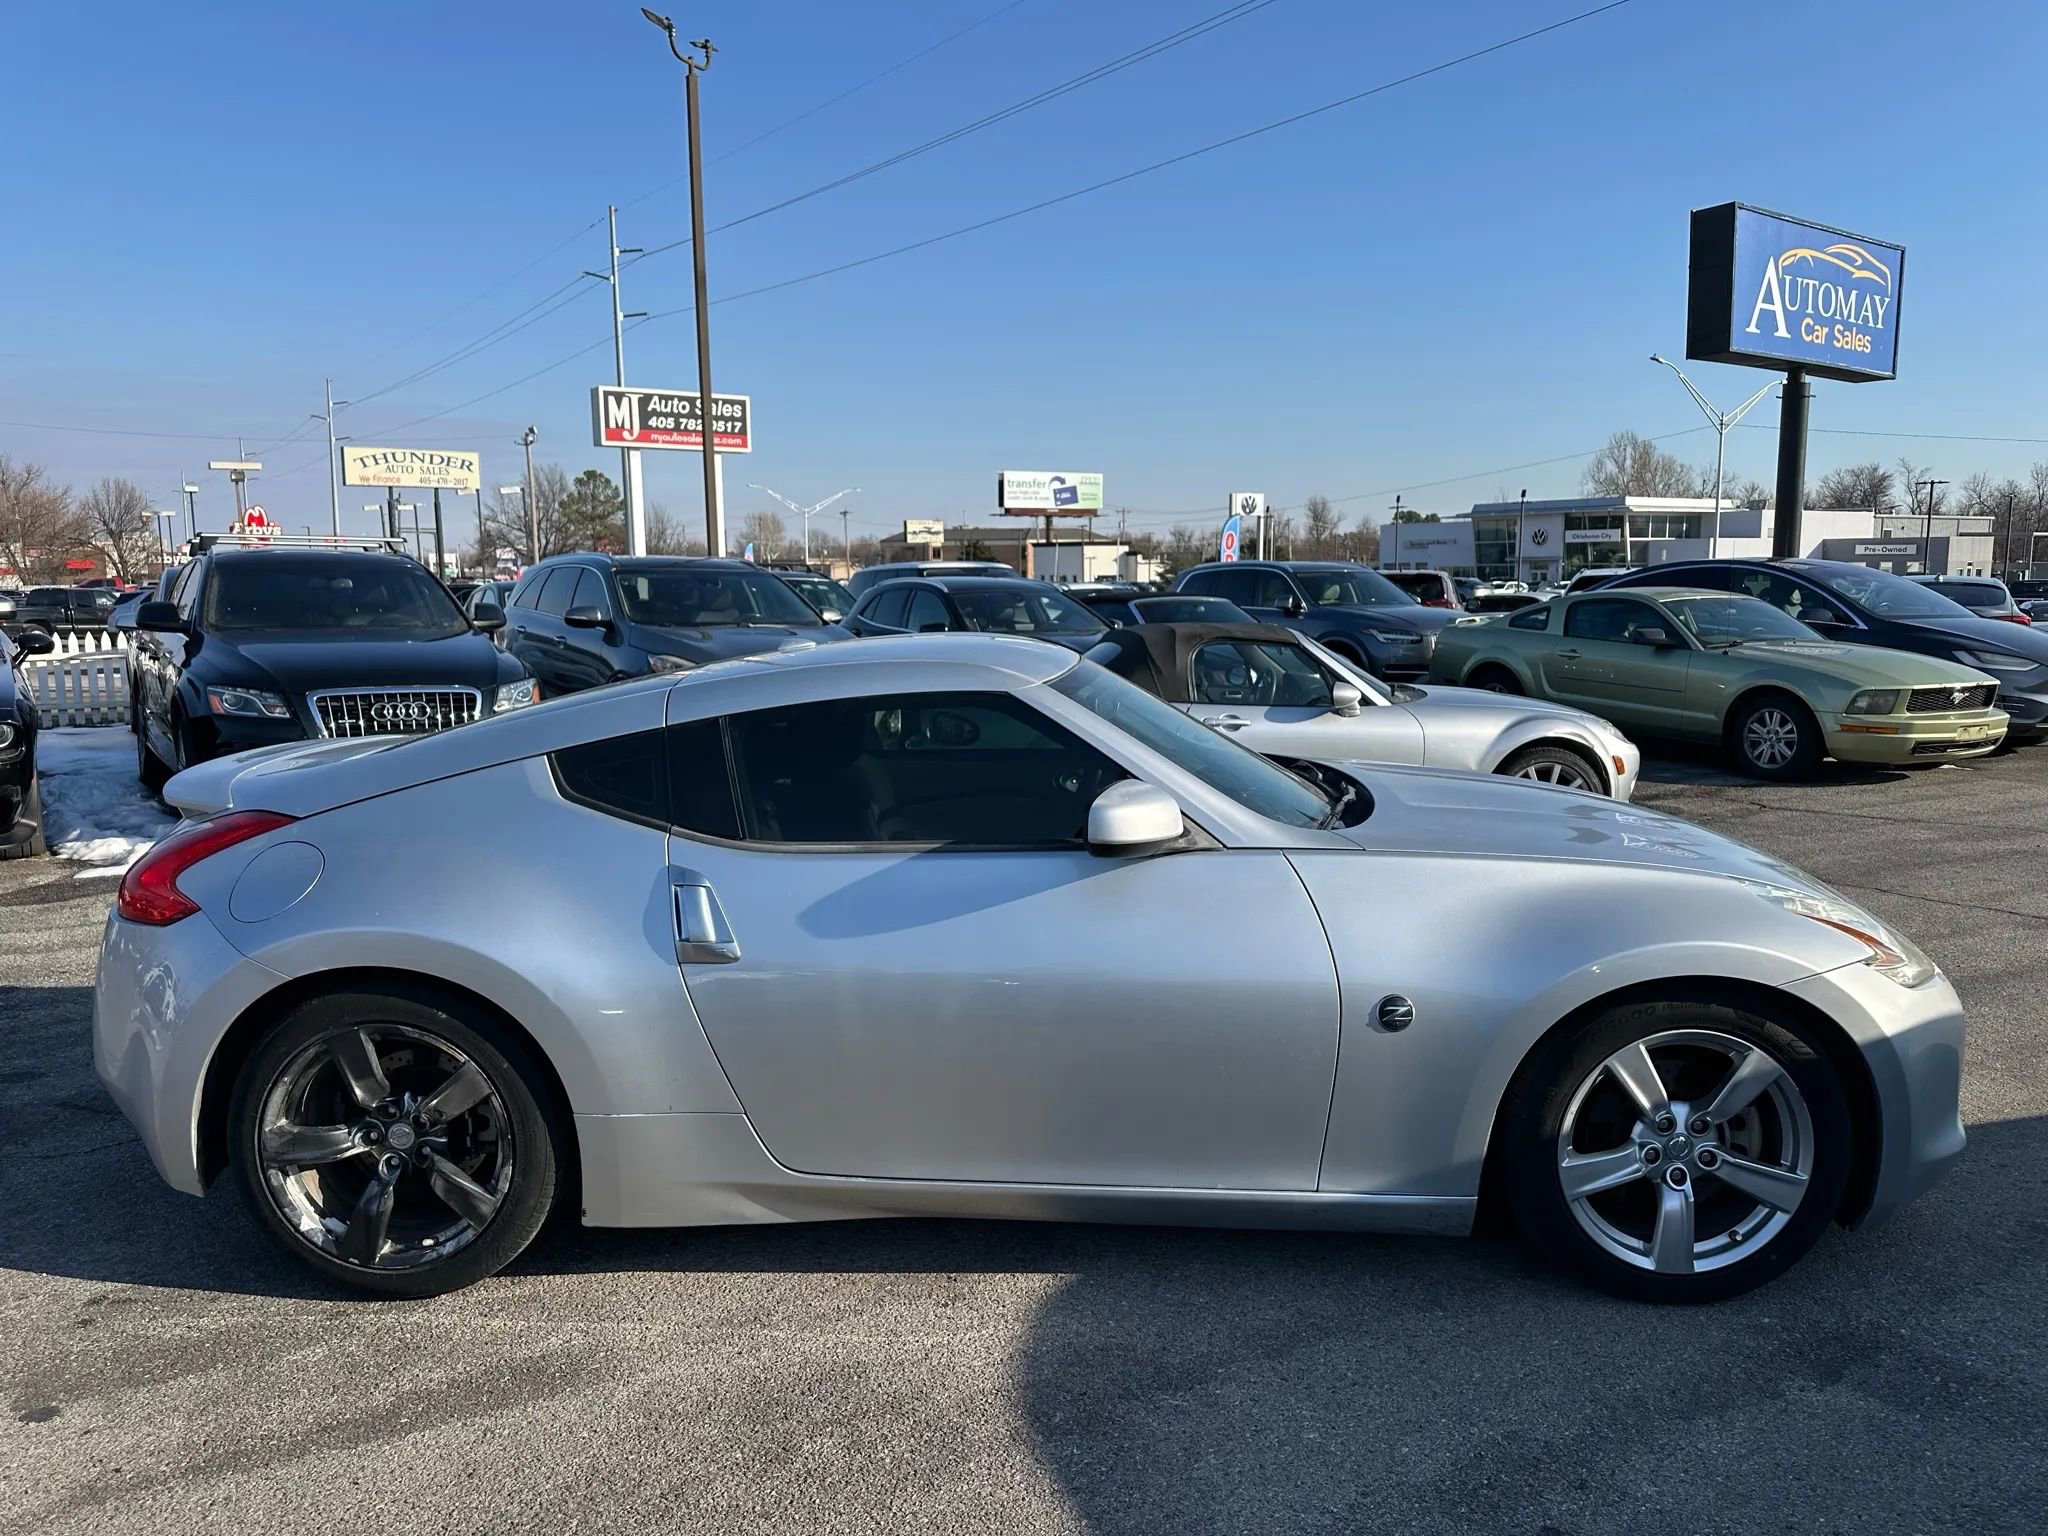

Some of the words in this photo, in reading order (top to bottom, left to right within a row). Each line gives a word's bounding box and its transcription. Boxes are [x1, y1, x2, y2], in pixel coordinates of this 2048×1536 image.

[1745, 256, 1891, 339] AUTOMAY
[1801, 317, 1829, 345] Car
[1833, 323, 1872, 353] Sales
[647, 395, 690, 414] Auto
[607, 393, 644, 441] MJ
[648, 416, 675, 429] 405
[679, 417, 703, 431] 782
[353, 451, 474, 473] THUNDER
[385, 465, 414, 475] AUTO
[419, 466, 450, 477] SALES
[358, 475, 371, 483] We
[373, 475, 406, 484] Finance
[1007, 478, 1047, 489] transfer
